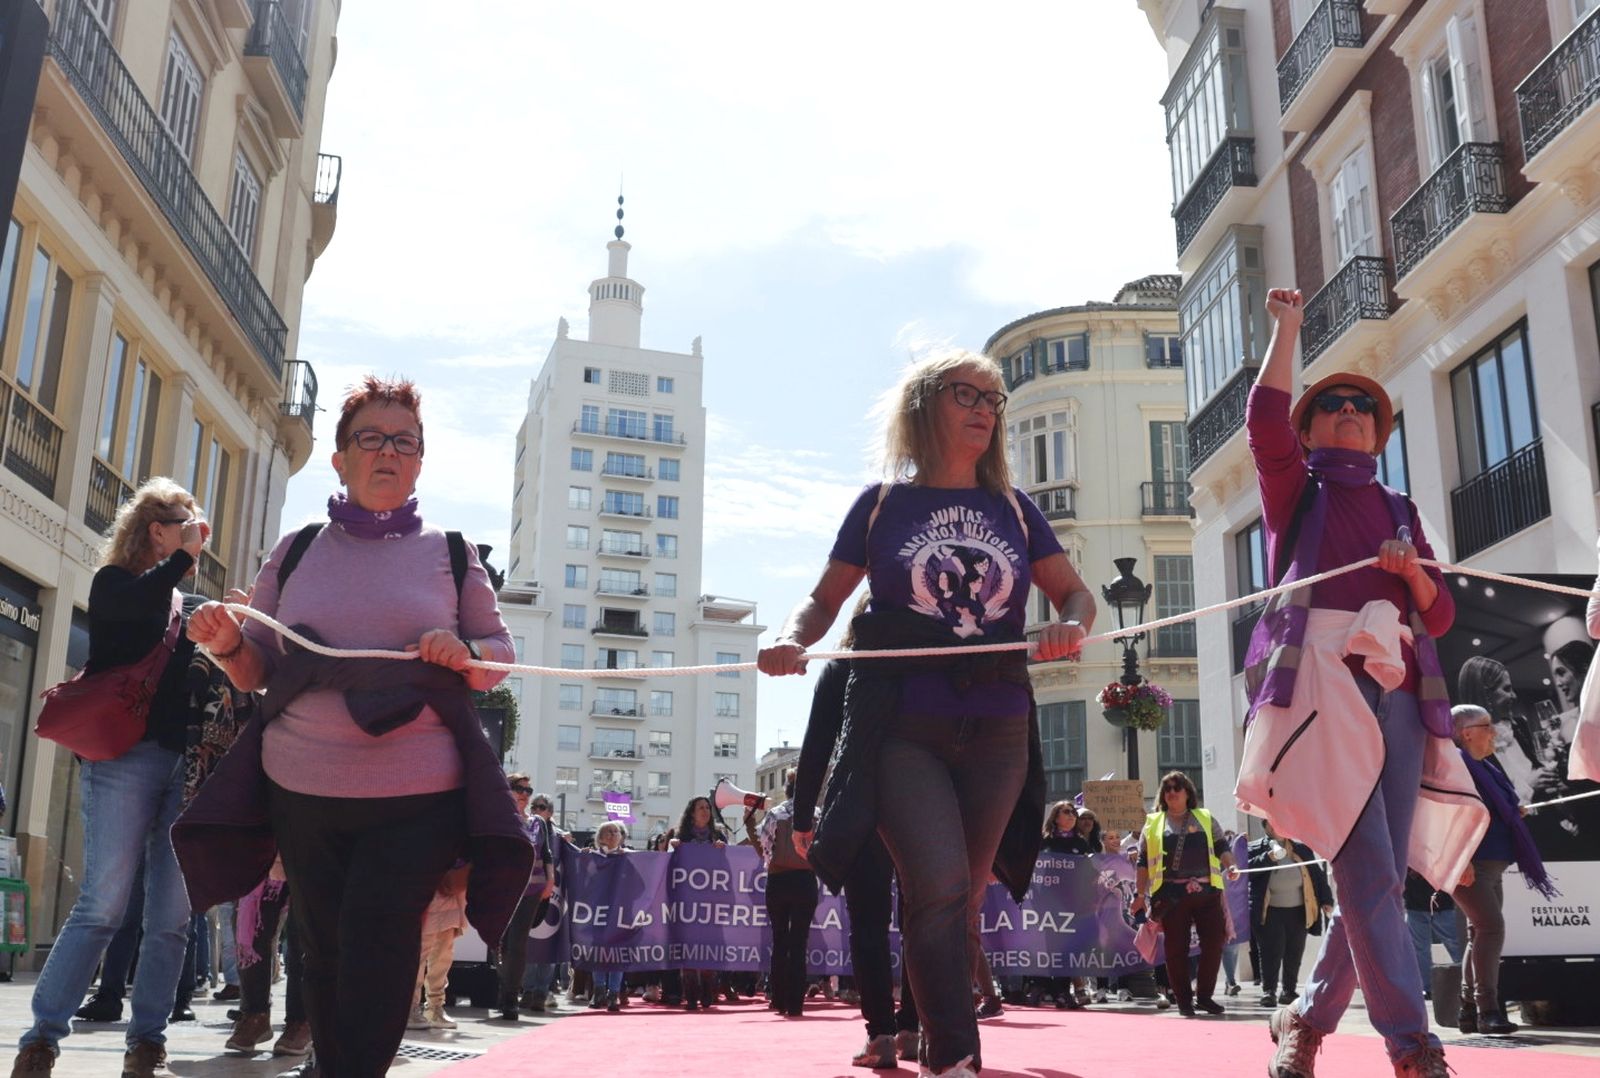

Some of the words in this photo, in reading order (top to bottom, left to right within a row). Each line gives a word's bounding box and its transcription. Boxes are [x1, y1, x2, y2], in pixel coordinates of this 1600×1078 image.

[930, 505, 984, 528] JUNTAS
[963, 522, 1019, 562] HISTORIA
[0, 598, 18, 621] simo
[21, 606, 41, 632] Dutti
[1035, 857, 1076, 870] onista
[672, 867, 730, 892] POR
[739, 870, 769, 893] LO
[1032, 872, 1060, 887] laga
[572, 901, 610, 926] DE
[661, 901, 772, 927] MUJERE
[980, 910, 1014, 934] LA
[1022, 909, 1076, 933] PAZ
[1531, 906, 1575, 915] FESTIVAL
[1578, 905, 1590, 914] DE
[571, 943, 665, 963] OVIMIENTO
[668, 944, 761, 963] FEMINISTA
[1037, 952, 1063, 969] DE
